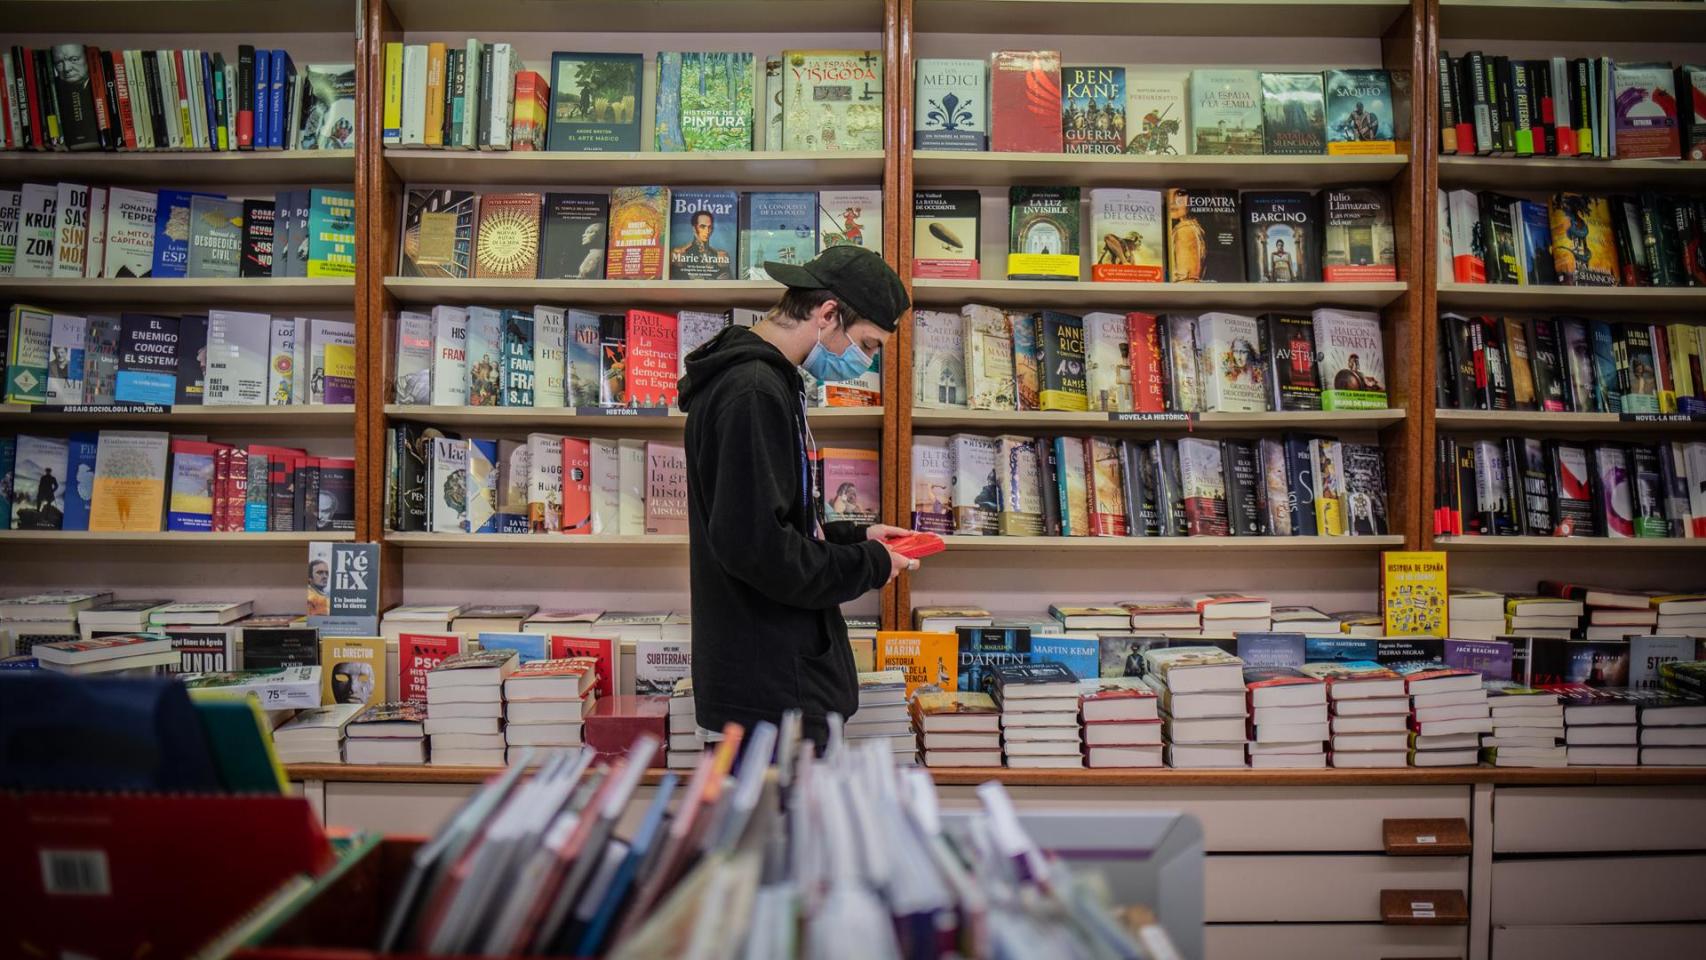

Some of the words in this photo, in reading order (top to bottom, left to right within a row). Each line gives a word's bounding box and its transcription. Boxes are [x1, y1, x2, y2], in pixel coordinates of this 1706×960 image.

[791, 67, 878, 82] VISIGODA
[1074, 69, 1112, 85] BEN
[1514, 65, 1527, 88] JAMES
[1067, 84, 1120, 99] KANE
[1336, 87, 1382, 97] SAQUEO
[682, 115, 746, 128] PINTURA
[1065, 129, 1121, 141] GUERRA
[1065, 143, 1122, 154] IMPERIOS
[1029, 199, 1043, 207] LA
[1044, 199, 1063, 207] LUZ
[1328, 192, 1351, 203] Julio
[674, 198, 733, 215] Bolívar
[1023, 206, 1069, 214] INVISIBLE
[1104, 203, 1115, 212] EL
[1118, 203, 1155, 213] TRONO
[1271, 204, 1285, 213] EN
[1328, 202, 1381, 216] Llamazares
[1251, 211, 1307, 224] BARCINO
[211, 246, 231, 262] CIVIL
[671, 253, 698, 264] Marie
[701, 252, 730, 265] Arana
[150, 319, 162, 329] EL
[633, 313, 662, 328] PAUL
[131, 330, 178, 343] ENEMIGO
[1057, 325, 1085, 341] ANNE
[134, 341, 175, 354] CONOCE
[640, 337, 653, 350] La
[1059, 339, 1085, 354] RICE
[1330, 335, 1378, 349] ESPARTA
[511, 342, 524, 356] LA
[124, 353, 138, 365] EL
[644, 358, 655, 369] de
[656, 359, 667, 370] la
[635, 377, 647, 388] en
[63, 405, 88, 413] ASSAIG
[89, 405, 129, 413] SOCIOLOGIA
[133, 403, 164, 413] POLÍTICA
[1669, 413, 1692, 422] NEGRA
[652, 469, 666, 482] la
[1388, 563, 1412, 572] HISTORIA
[1414, 563, 1421, 572] DE
[1423, 562, 1444, 572] ESPAÑA
[334, 596, 342, 604] Un
[343, 596, 367, 604] hombre
[334, 647, 341, 658] EL
[885, 645, 921, 657] MARINA
[1034, 646, 1068, 656] MARTIN
[1070, 647, 1096, 657] KEMP
[1456, 646, 1470, 654] JACK
[1472, 647, 1499, 655] REACHER
[885, 657, 914, 666] HISTORIA
[909, 666, 917, 675] DE
[918, 666, 927, 675] LA
[267, 689, 279, 701] 75
